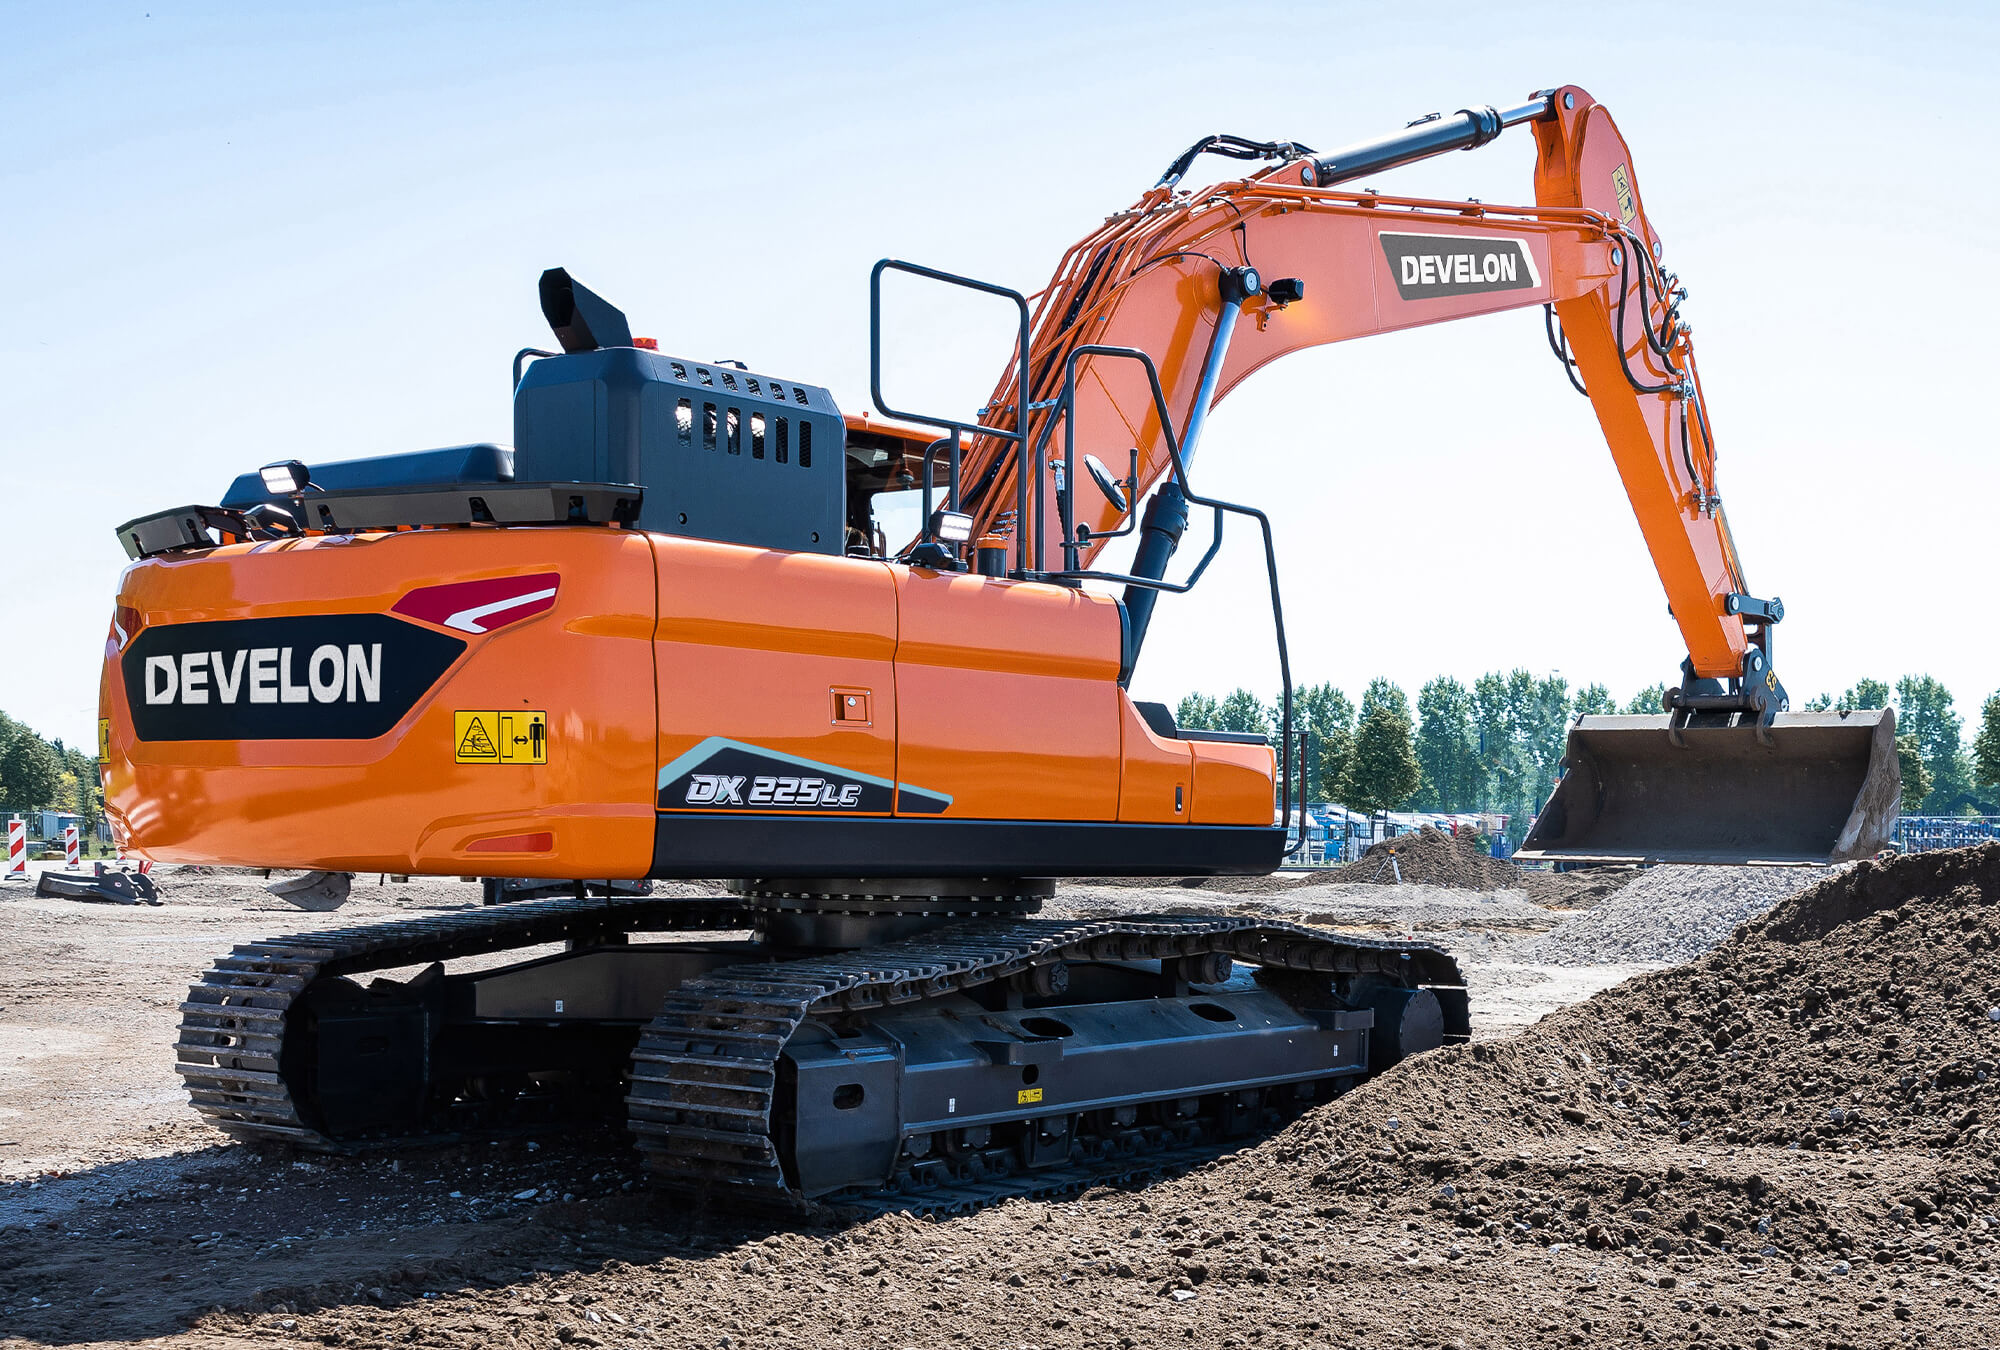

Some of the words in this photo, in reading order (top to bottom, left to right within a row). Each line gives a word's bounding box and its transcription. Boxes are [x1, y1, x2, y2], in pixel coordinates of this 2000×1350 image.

[1401, 253, 1517, 285] DEVELON
[145, 643, 382, 704] DEVELON
[686, 774, 746, 805] DX
